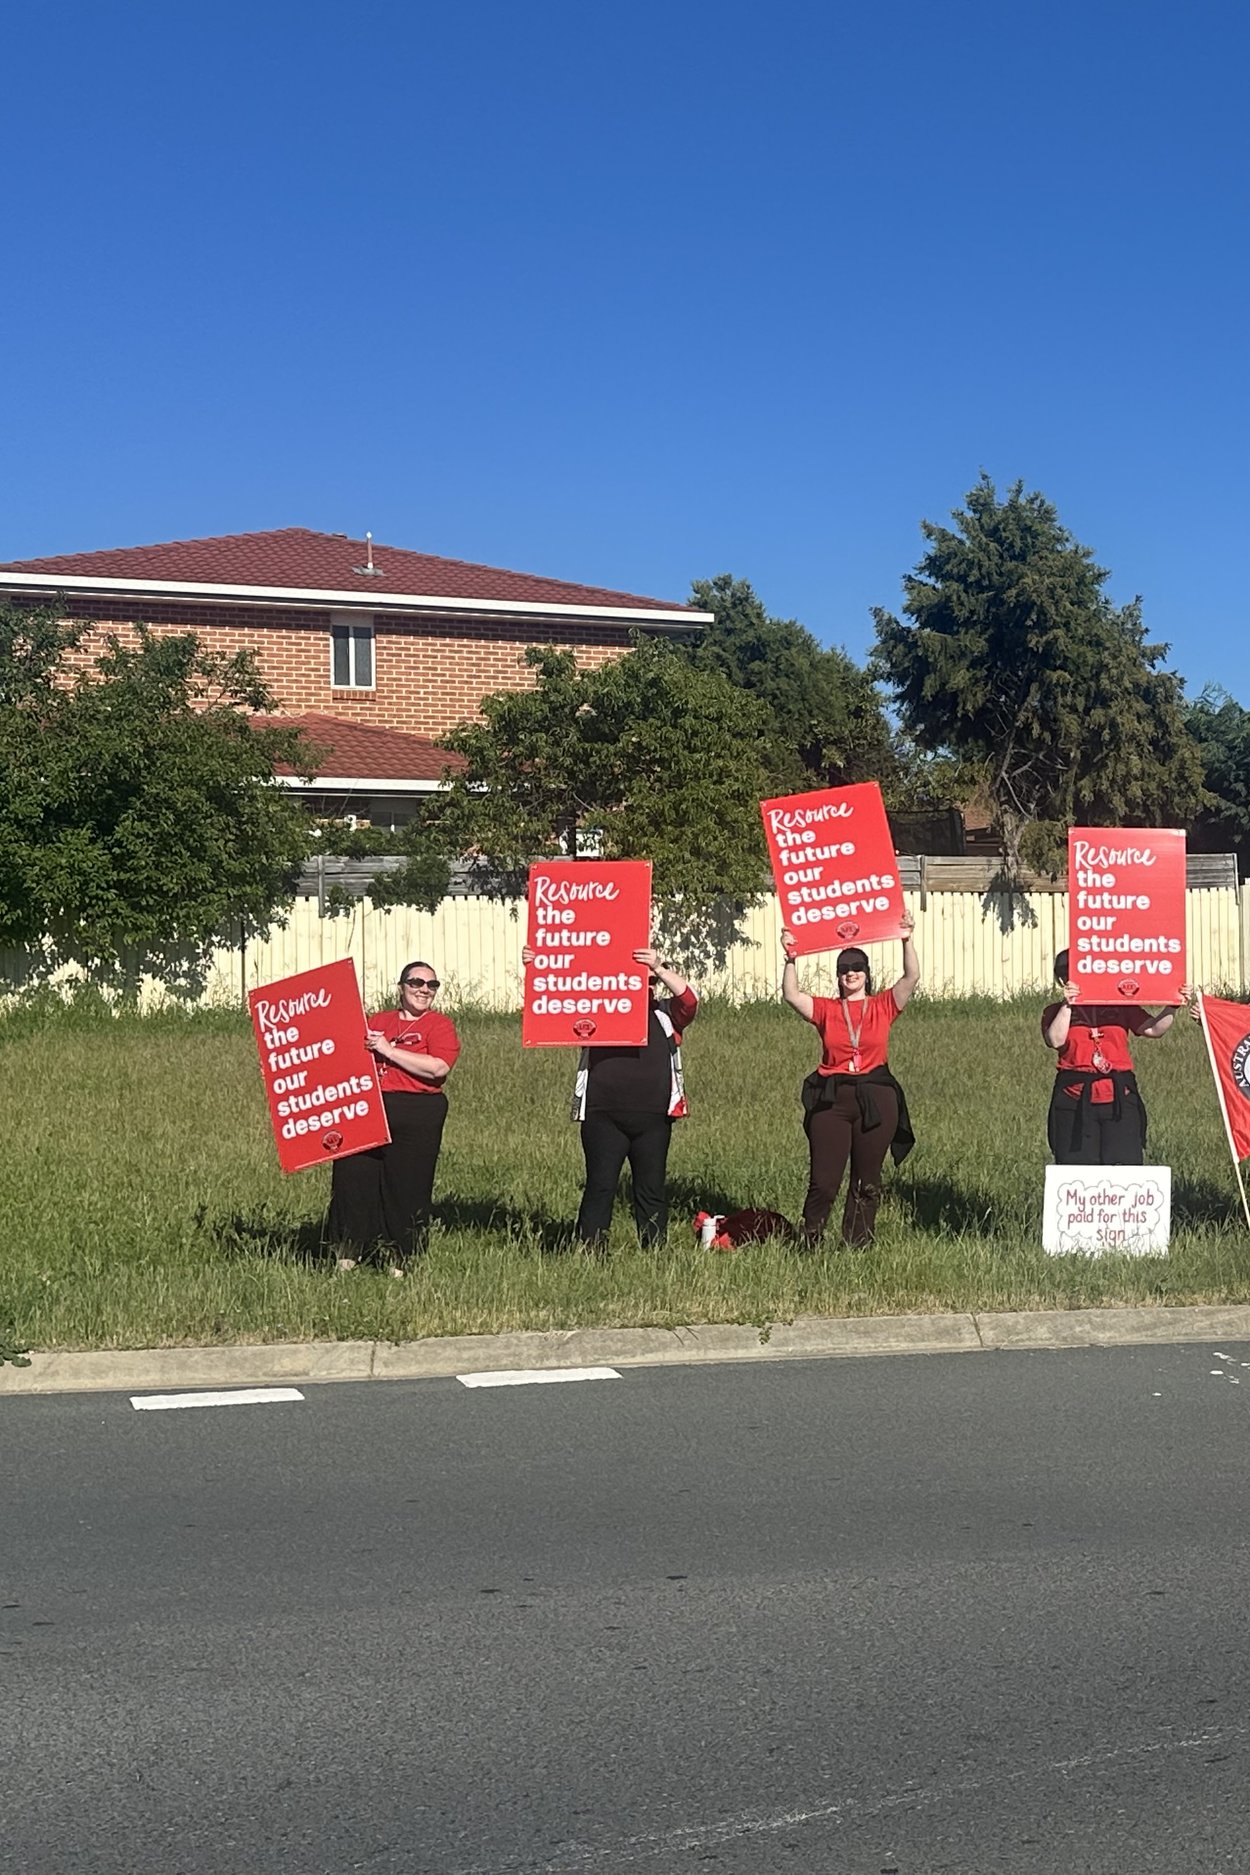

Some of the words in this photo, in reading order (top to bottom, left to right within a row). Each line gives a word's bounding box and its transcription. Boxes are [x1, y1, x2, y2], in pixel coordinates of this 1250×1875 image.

[768, 801, 853, 834] Resource
[776, 828, 816, 846] the
[779, 841, 855, 866] future
[1074, 841, 1156, 870] Resource
[783, 866, 822, 885] our
[1077, 869, 1115, 887] the
[534, 876, 619, 906] Resource
[788, 873, 895, 905] students
[791, 897, 889, 925] deserve
[1077, 892, 1150, 910] future
[536, 906, 576, 924] the
[1077, 914, 1116, 931] our
[536, 929, 610, 947] future
[1077, 934, 1181, 953] students
[535, 952, 574, 969] our
[1077, 956, 1172, 974] deserve
[533, 973, 642, 992] students
[255, 987, 331, 1032] Resource
[532, 996, 632, 1014] deserve
[264, 1024, 299, 1049] the
[269, 1039, 335, 1071] future
[273, 1072, 307, 1094] our
[278, 1075, 373, 1117] students
[282, 1100, 370, 1139] deserve
[1066, 1189, 1085, 1212] My
[1090, 1188, 1125, 1205] other
[1132, 1188, 1154, 1208] job
[1068, 1208, 1094, 1230] paid
[1097, 1208, 1117, 1224] for
[1122, 1208, 1146, 1223] this
[1096, 1228, 1126, 1246] sign
